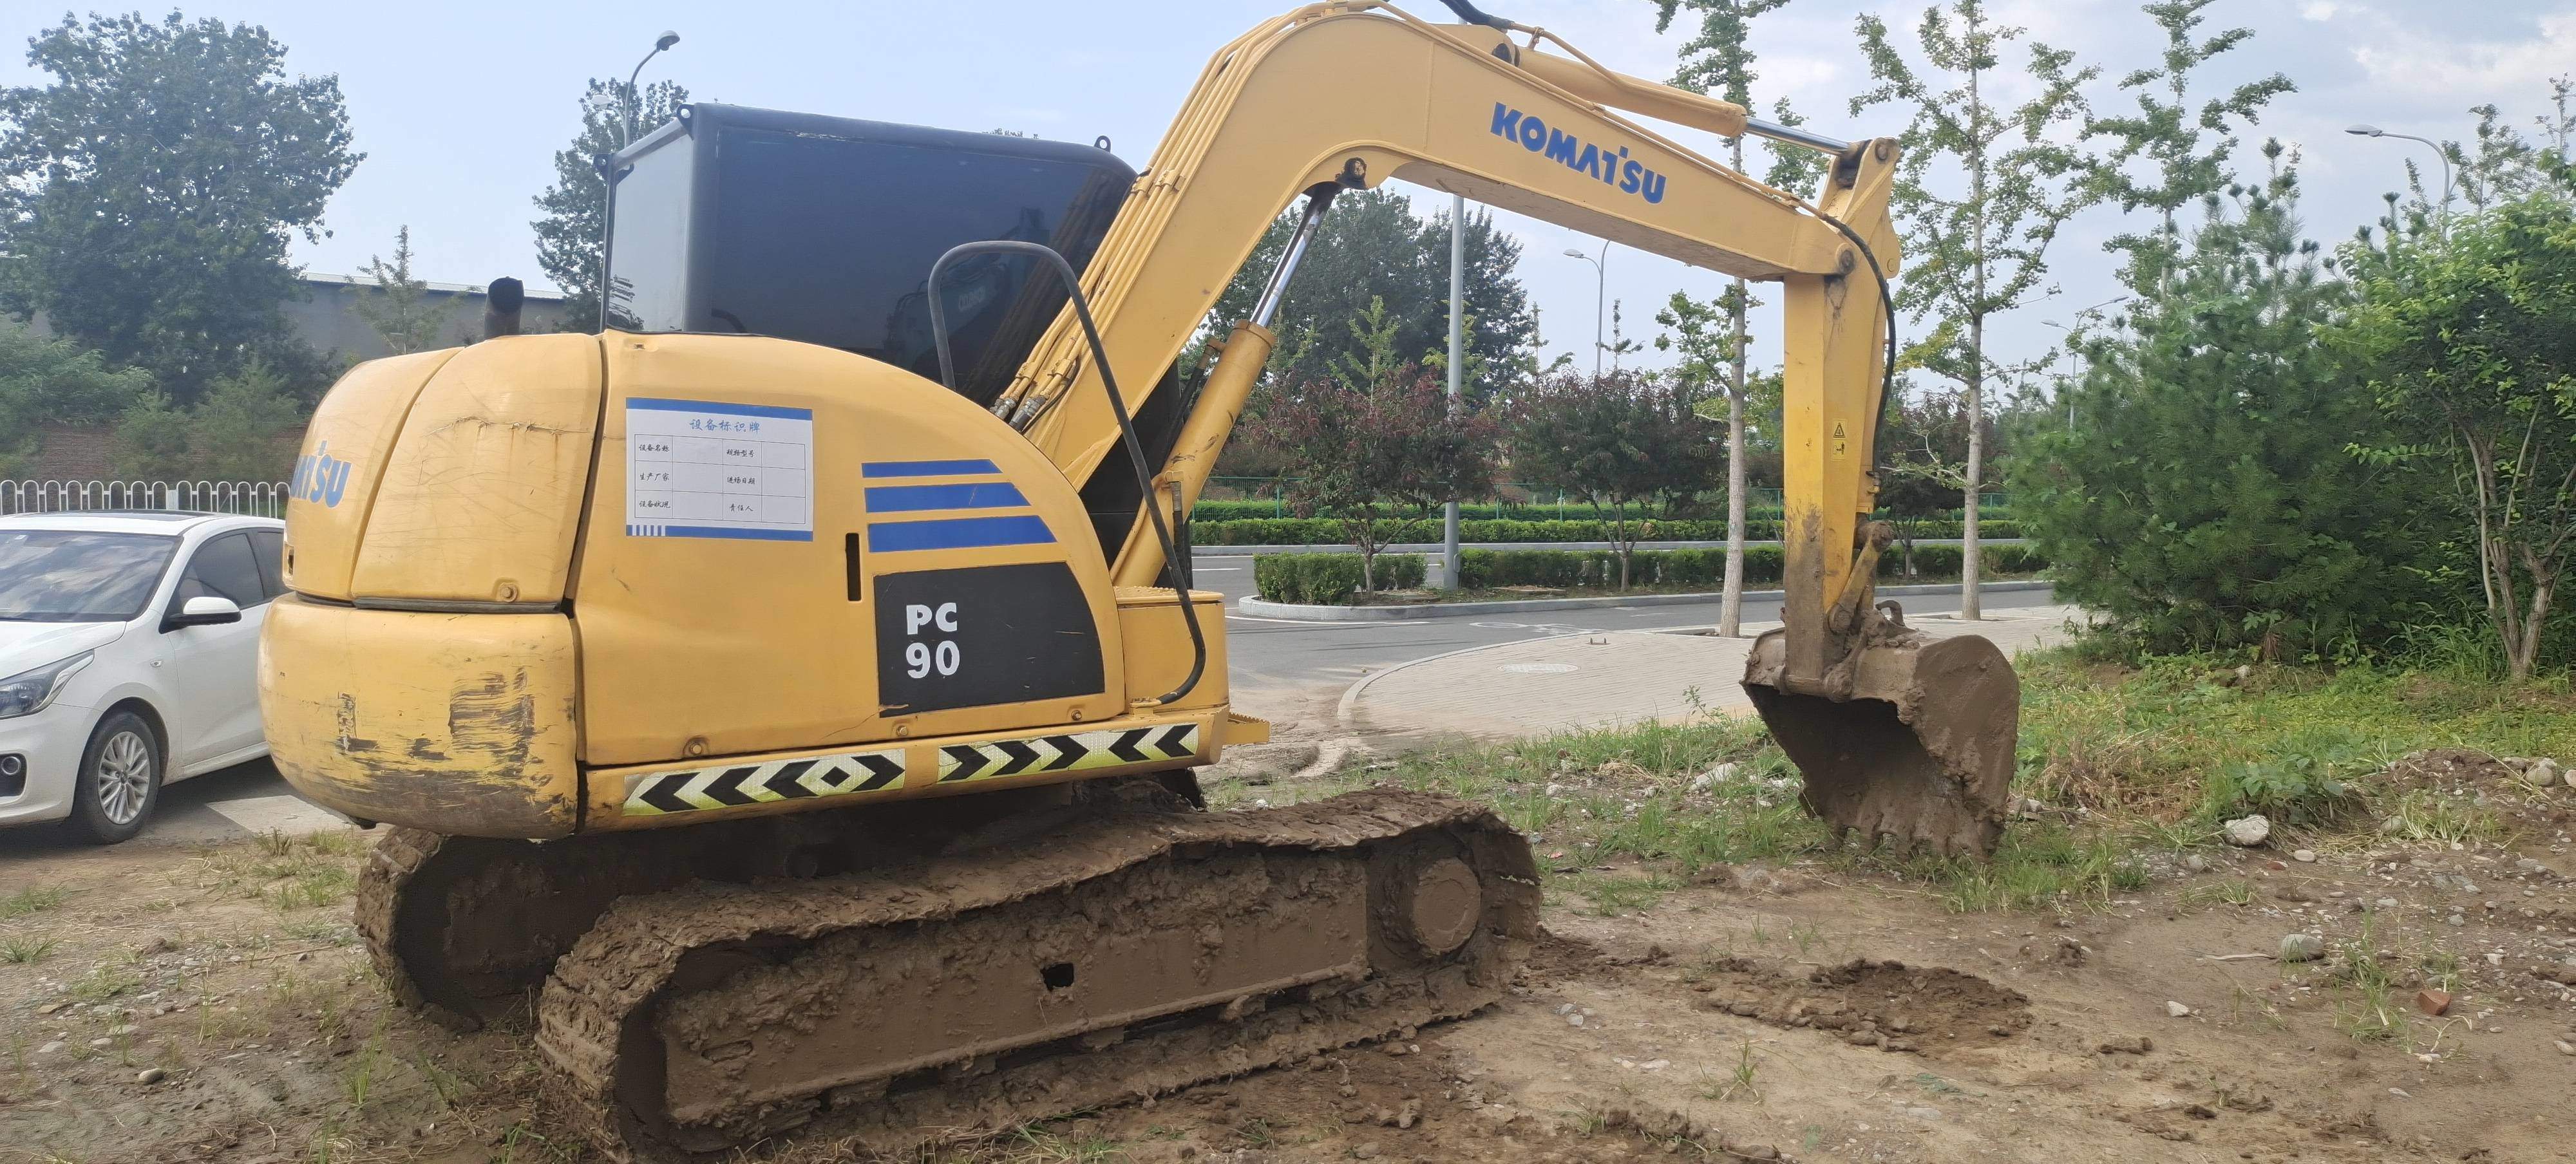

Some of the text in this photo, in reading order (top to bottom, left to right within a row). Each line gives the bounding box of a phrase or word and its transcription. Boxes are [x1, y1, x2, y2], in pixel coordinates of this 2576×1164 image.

[1490, 101, 1667, 204] KOMATSU
[689, 418, 761, 435] 设备标识牌
[639, 472, 670, 482] 生产厂家
[729, 503, 753, 512] 责任人
[906, 602, 958, 635] PC
[905, 640, 960, 679] 90
